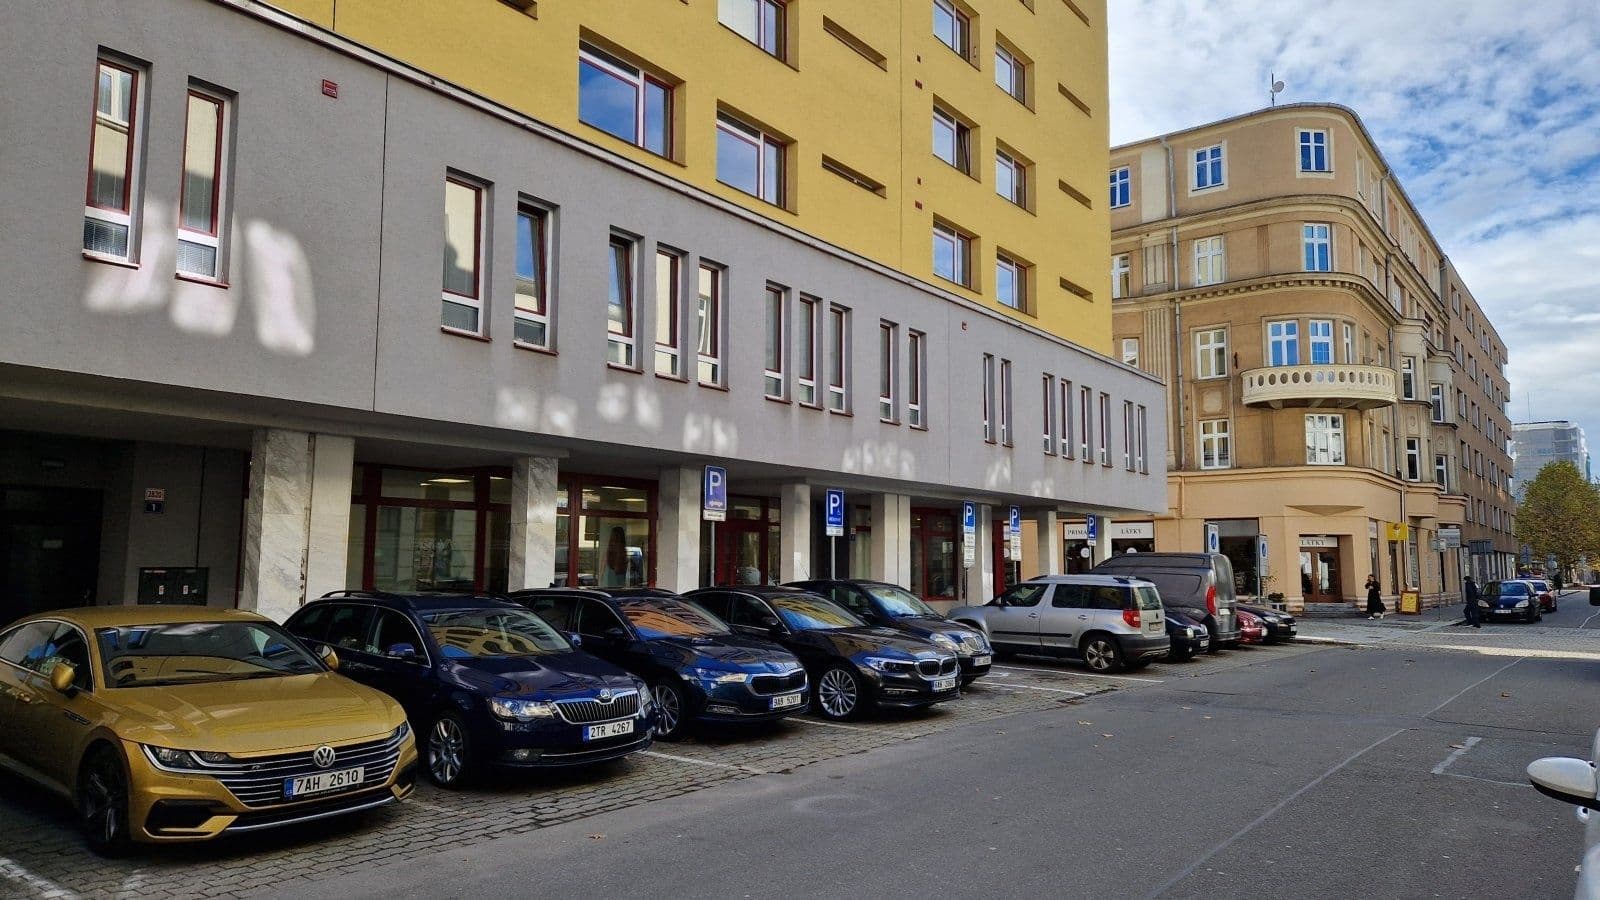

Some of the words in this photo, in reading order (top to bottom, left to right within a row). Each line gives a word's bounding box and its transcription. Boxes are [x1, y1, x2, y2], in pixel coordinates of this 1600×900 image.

[709, 470, 722, 496] P
[830, 494, 840, 515] P
[965, 505, 973, 523] P
[1011, 508, 1018, 525] P
[1088, 517, 1095, 533] P
[591, 725, 606, 738] 2TR
[611, 721, 630, 734] 4267
[297, 777, 320, 793] 7AH
[329, 769, 359, 787] 2610
